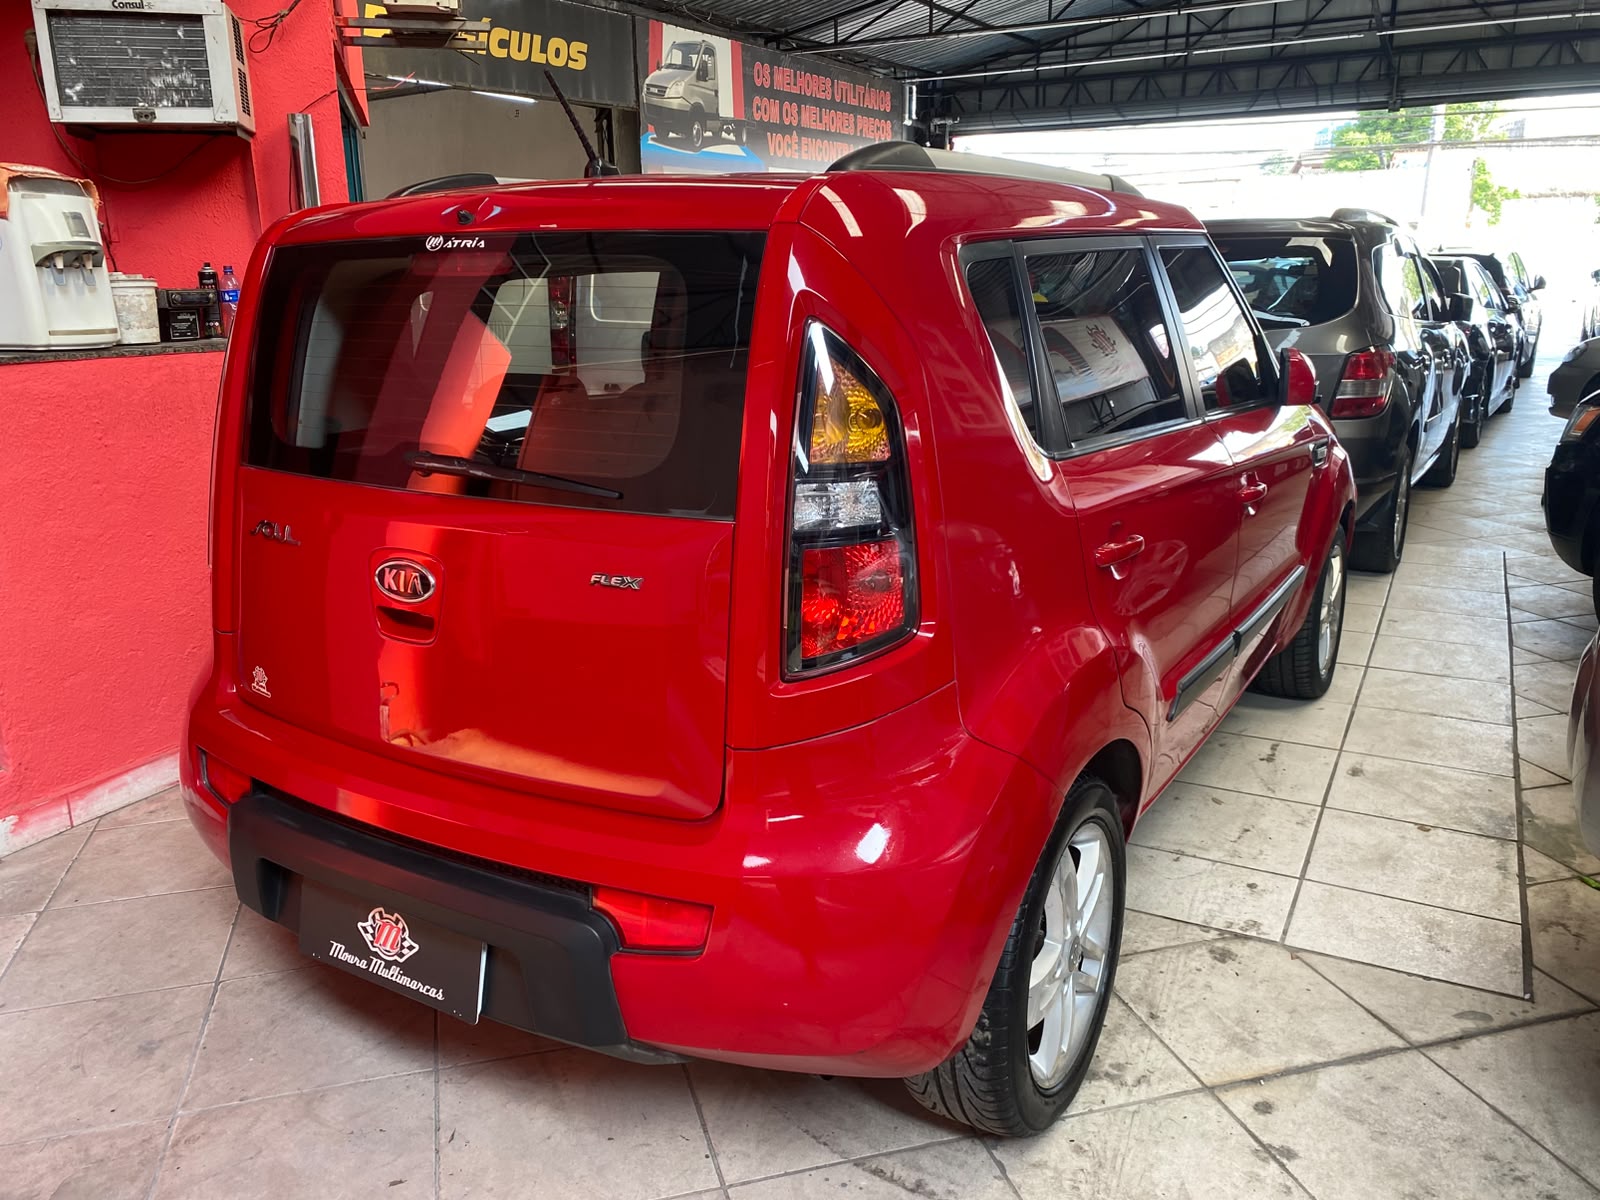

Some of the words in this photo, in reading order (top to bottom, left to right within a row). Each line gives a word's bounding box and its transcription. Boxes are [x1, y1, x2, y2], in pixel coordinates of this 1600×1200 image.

[112, 0, 145, 9] Consul
[753, 61, 771, 88] OS
[773, 65, 832, 101] MELHORES
[834, 79, 892, 112] UTILITÁRIOS
[752, 96, 780, 124] COM
[782, 101, 799, 126] OS
[801, 104, 855, 136] MELHORES
[857, 115, 892, 143] PREÇOS
[767, 130, 799, 159] VOCÊ
[383, 567, 424, 595] KIA
[590, 572, 644, 590] FLEX
[329, 940, 370, 970] Moura
[368, 955, 445, 1001] Multimarcas
